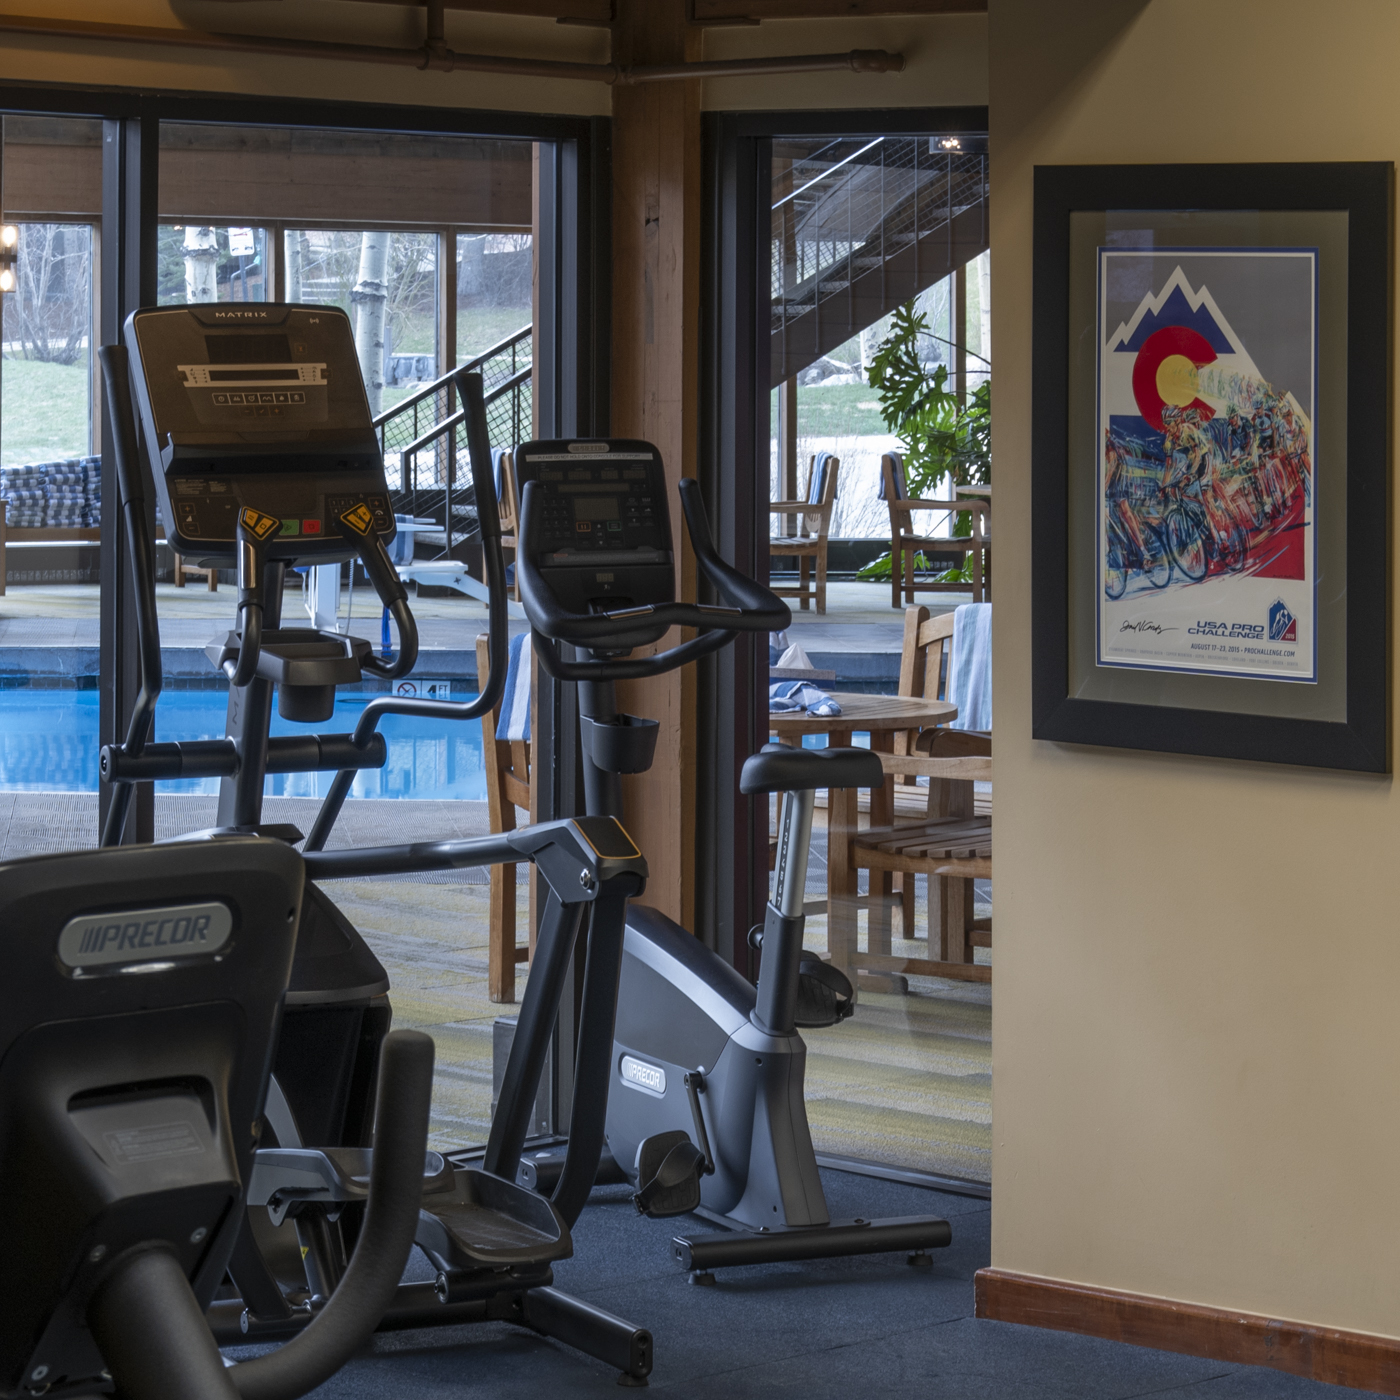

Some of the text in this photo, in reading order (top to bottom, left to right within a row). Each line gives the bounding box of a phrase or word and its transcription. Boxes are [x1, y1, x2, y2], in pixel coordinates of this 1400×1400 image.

[1188, 628, 1264, 640] CHALLENGE
[1197, 621, 1264, 633] USA PRO
[1191, 643, 1211, 651] AUGUST
[1244, 647, 1296, 657] PROCHALLENGE.COM
[98, 914, 211, 952] PRECOR
[631, 1063, 660, 1088] PRECOR
